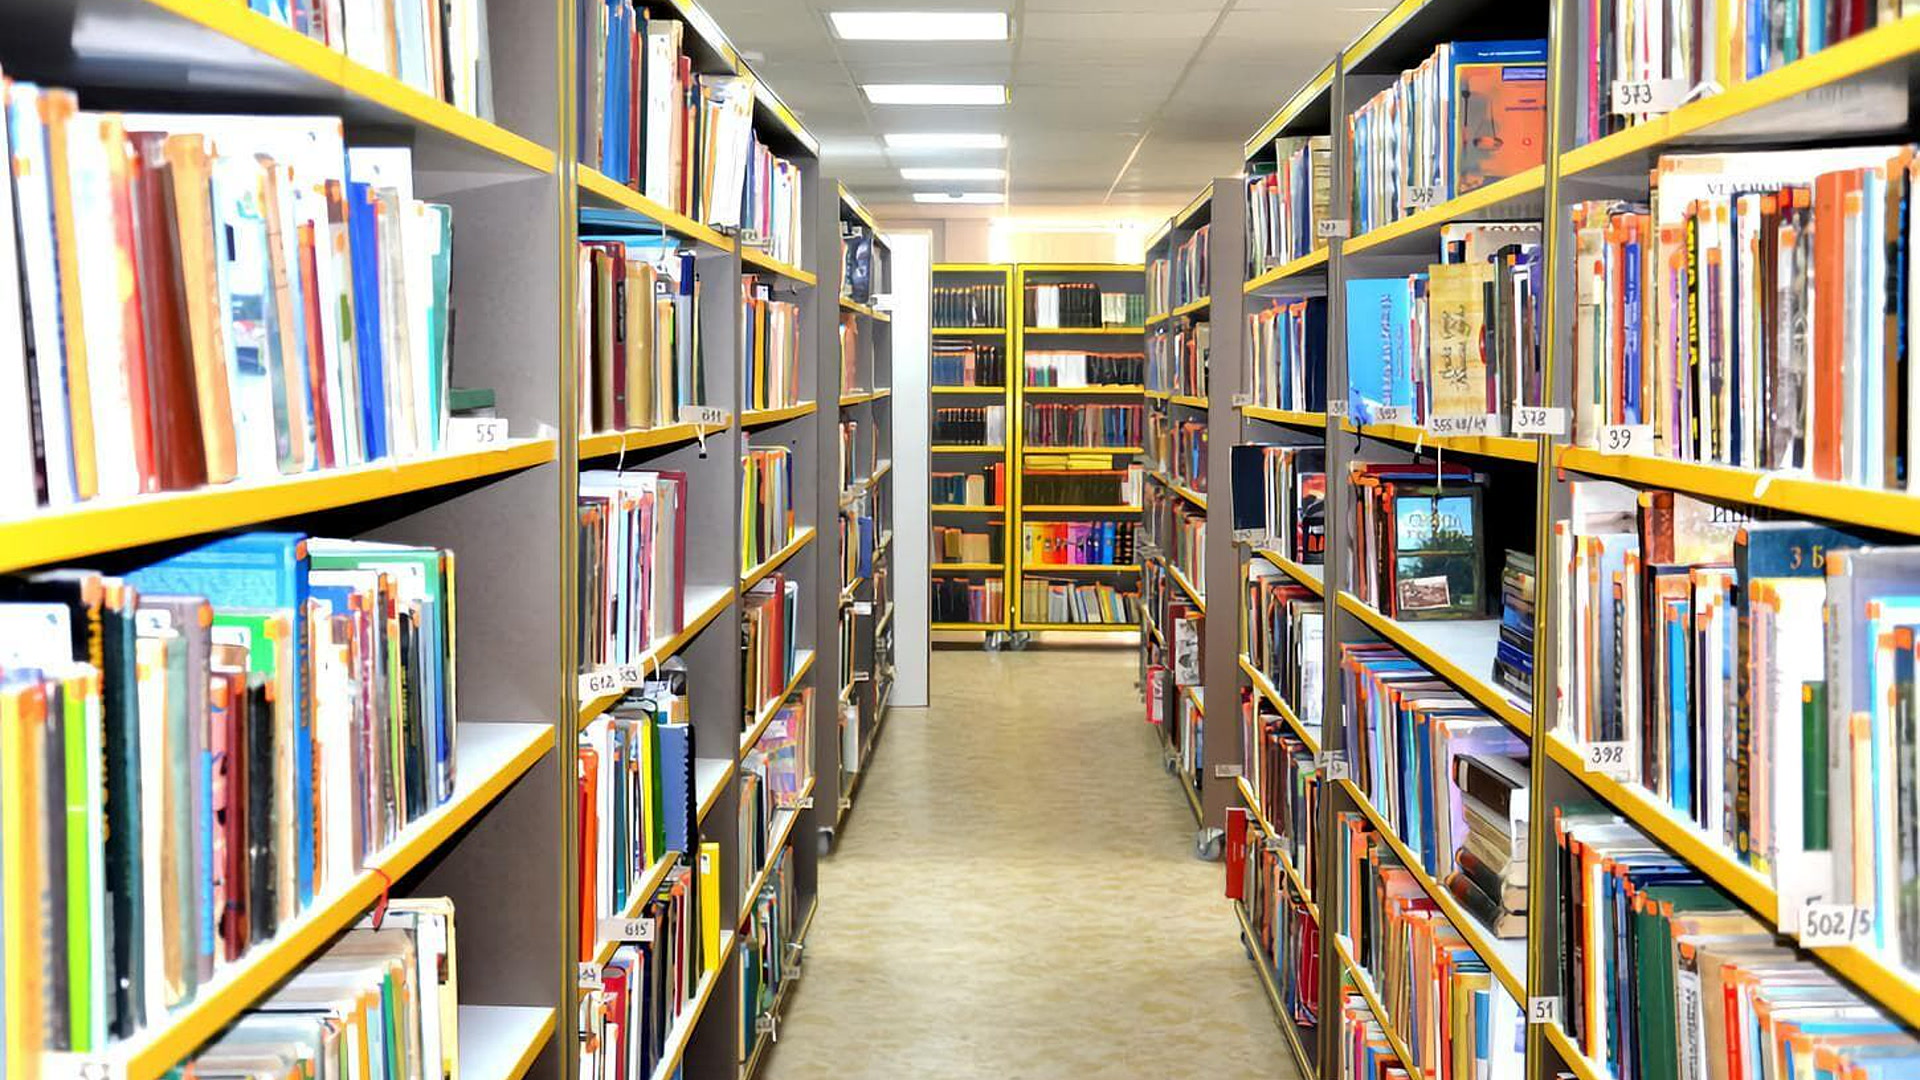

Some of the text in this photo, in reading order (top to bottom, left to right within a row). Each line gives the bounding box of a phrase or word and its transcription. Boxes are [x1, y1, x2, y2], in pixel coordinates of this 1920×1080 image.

[1620, 83, 1653, 105] 373
[1517, 409, 1547, 427] 378
[475, 423, 496, 443] 55
[1608, 428, 1632, 450] 39
[1590, 746, 1623, 764] 398
[1535, 999, 1554, 1019] 51
